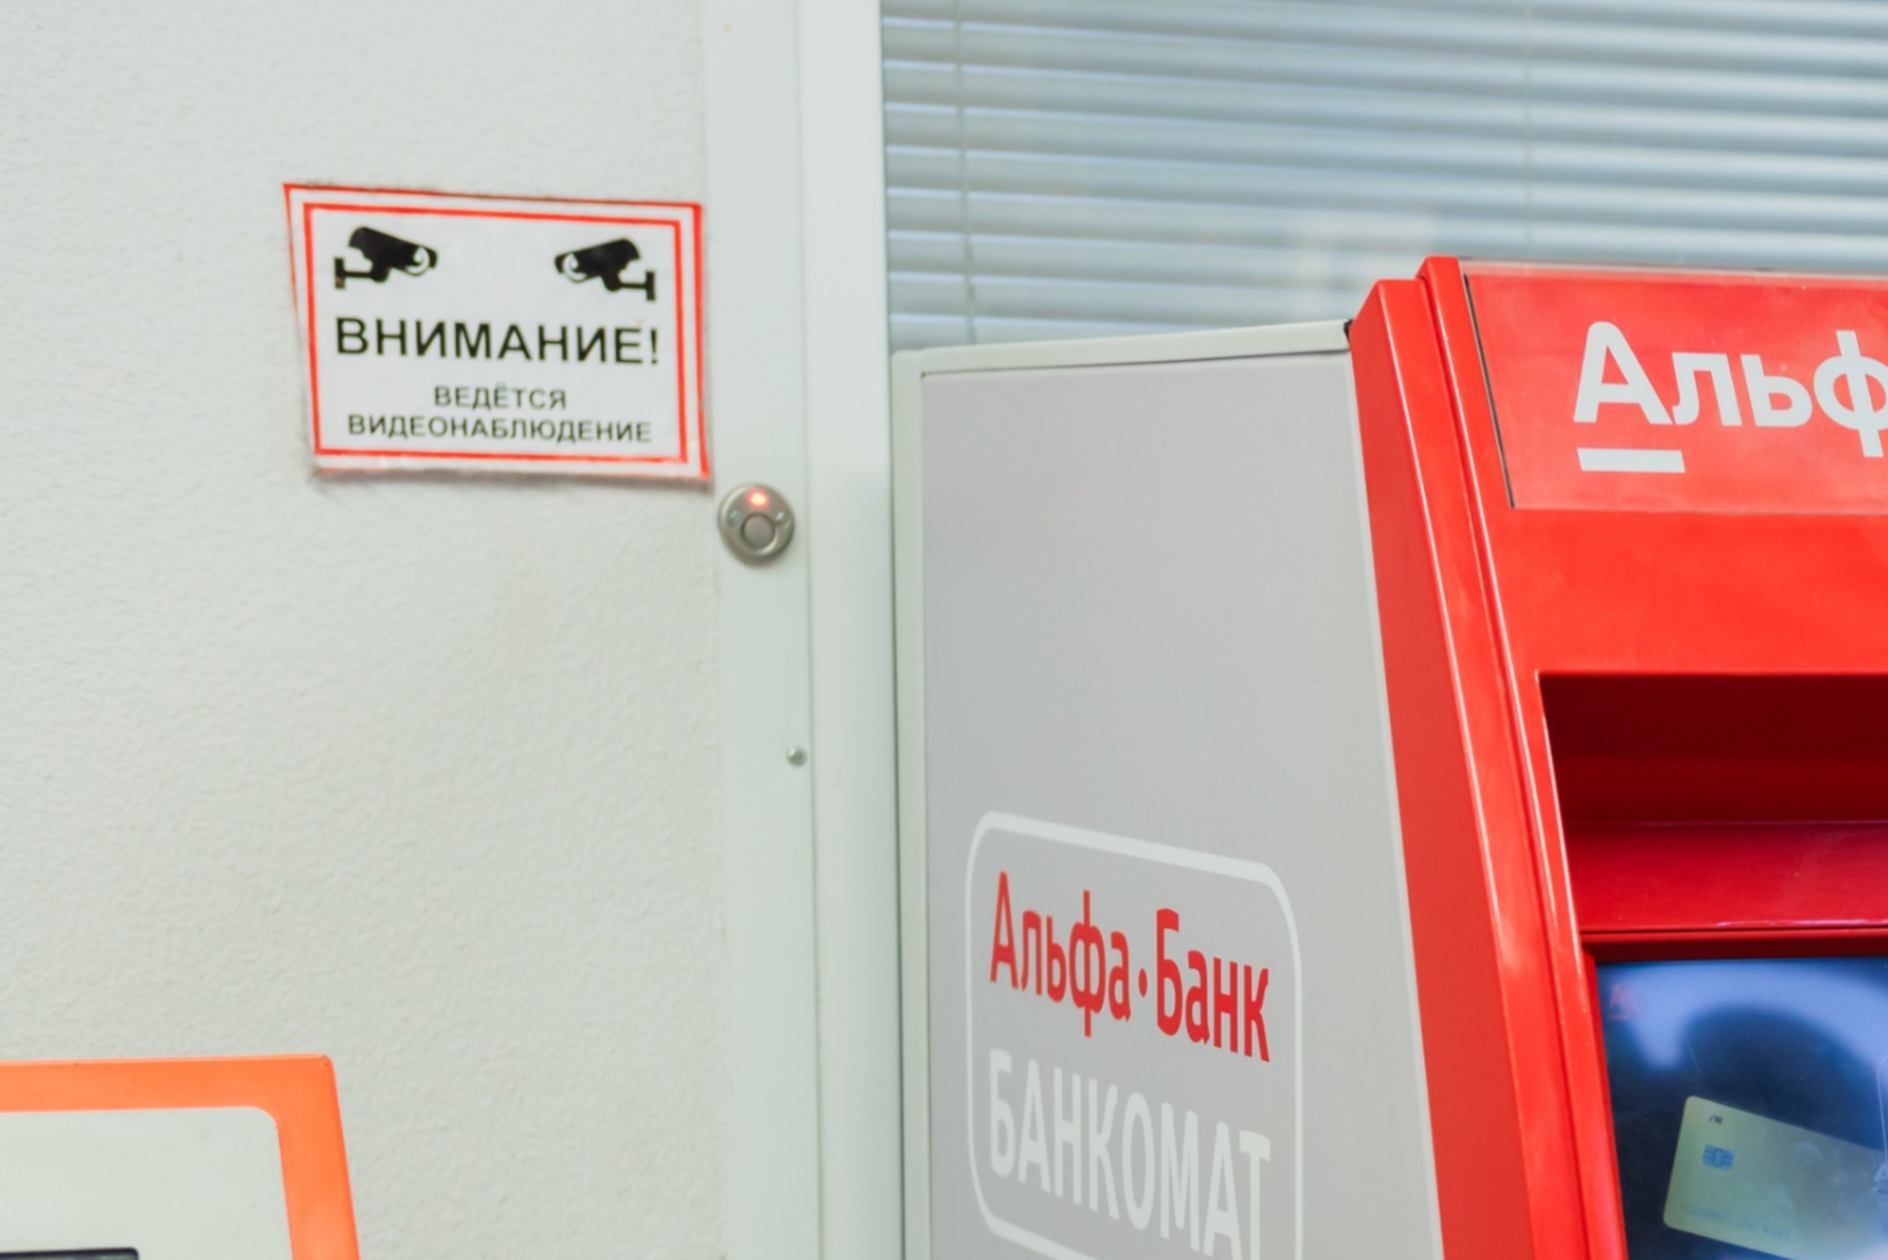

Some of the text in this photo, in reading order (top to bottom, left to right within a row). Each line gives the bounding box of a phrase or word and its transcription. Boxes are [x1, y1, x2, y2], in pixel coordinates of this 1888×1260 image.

[335, 316, 660, 366] ВНИМАНИЕ!
[433, 382, 568, 411] ВЕДЁТСЯ
[347, 413, 653, 444] ВИДЕОНАБЛЮДЕНИЕ
